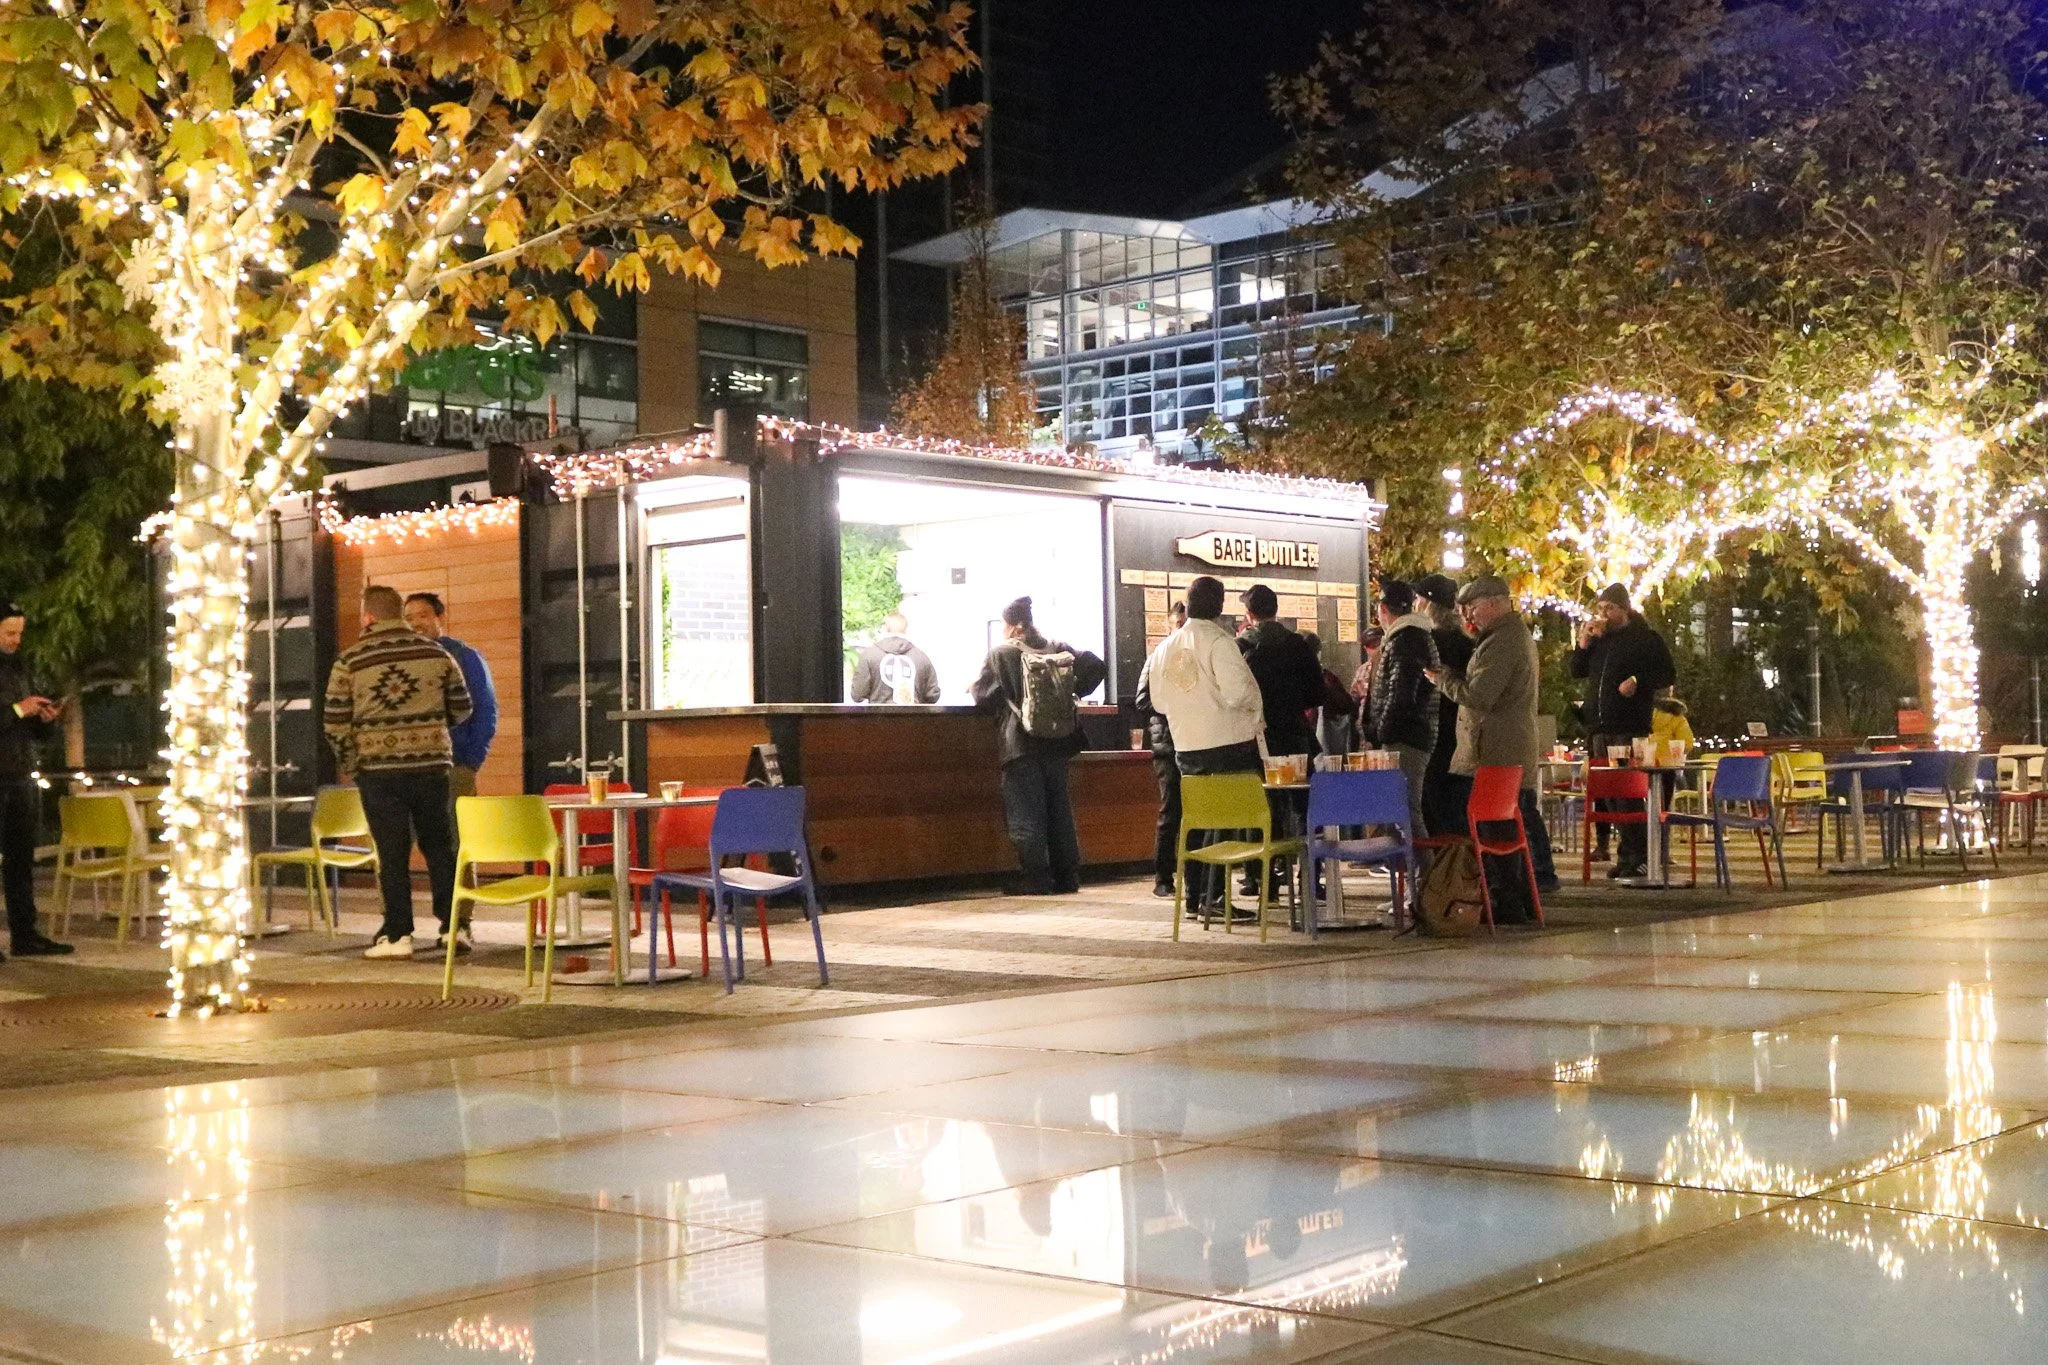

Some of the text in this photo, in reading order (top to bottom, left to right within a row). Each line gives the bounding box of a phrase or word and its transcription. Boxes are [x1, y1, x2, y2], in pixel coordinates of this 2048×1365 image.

[412, 410, 594, 445] by BLACKR
[1213, 537, 1252, 562] BARE
[1258, 540, 1308, 567] BOTTLE
